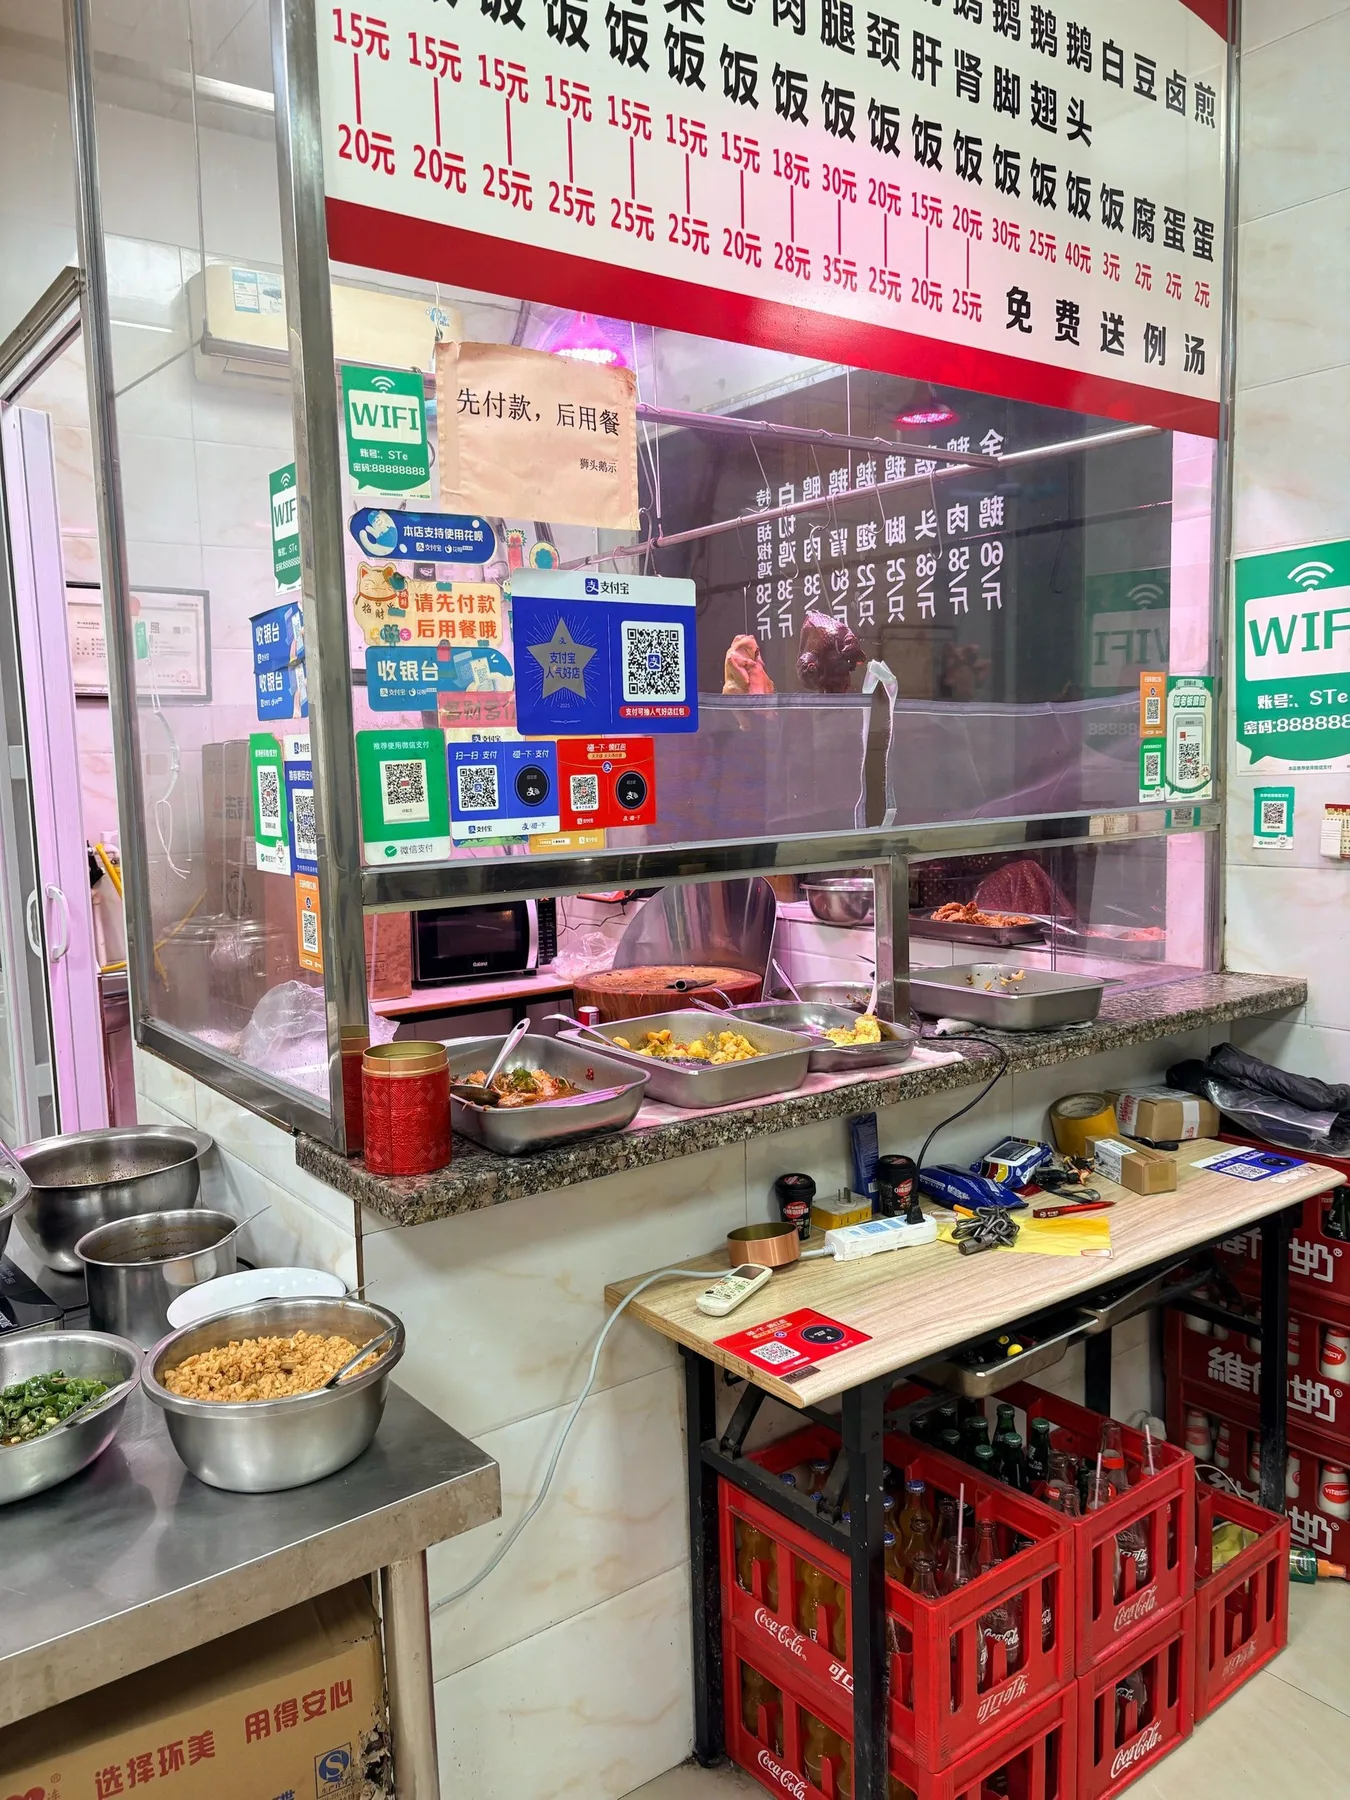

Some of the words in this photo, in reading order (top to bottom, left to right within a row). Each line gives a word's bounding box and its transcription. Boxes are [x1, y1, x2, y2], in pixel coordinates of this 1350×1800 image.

[332, 8, 390, 61] 15元
[408, 32, 462, 83] 15元
[478, 54, 529, 104] 15元
[545, 75, 592, 123] 15元
[607, 95, 652, 141] 15元
[666, 113, 708, 158] 15元
[338, 123, 396, 176] 20元
[413, 144, 467, 194] 20元
[721, 131, 761, 174] 15元
[773, 148, 810, 190] 18元
[483, 163, 533, 211] 25元
[548, 180, 596, 227] 25元
[822, 163, 858, 204] 30元
[868, 177, 902, 217] 20元
[610, 197, 655, 242] 25元
[911, 191, 943, 230] 15元
[952, 204, 983, 242] 20元
[668, 213, 710, 256] 25元
[722, 227, 762, 269] 20元
[992, 217, 1021, 253] 30元
[1029, 229, 1057, 264] 25元
[774, 241, 811, 281] 28元
[823, 254, 858, 292] 35元
[1065, 242, 1091, 274] 40元
[1102, 252, 1120, 282] 3元
[1135, 262, 1152, 291] 2元
[868, 266, 902, 303] 25元
[911, 277, 943, 313] 20元
[1165, 272, 1182, 300] 2元
[1194, 281, 1210, 308] 2元
[952, 288, 983, 323] 25元
[1006, 285, 1205, 376] 免费送例汤
[350, 401, 420, 431] WIFI
[456, 387, 620, 437] 先付款，后用餐
[414, 592, 497, 614] 请先付款
[600, 581, 630, 595] 支付宝
[417, 619, 498, 640] 后用餐哦
[1248, 607, 1350, 657] WIF
[376, 660, 444, 682] 收银台
[545, 666, 581, 680] 人气好店
[549, 651, 577, 665] 支付宝
[1309, 688, 1349, 706] STe
[94, 1728, 217, 1800] 选择环美
[244, 1678, 354, 1745] 用得安心
